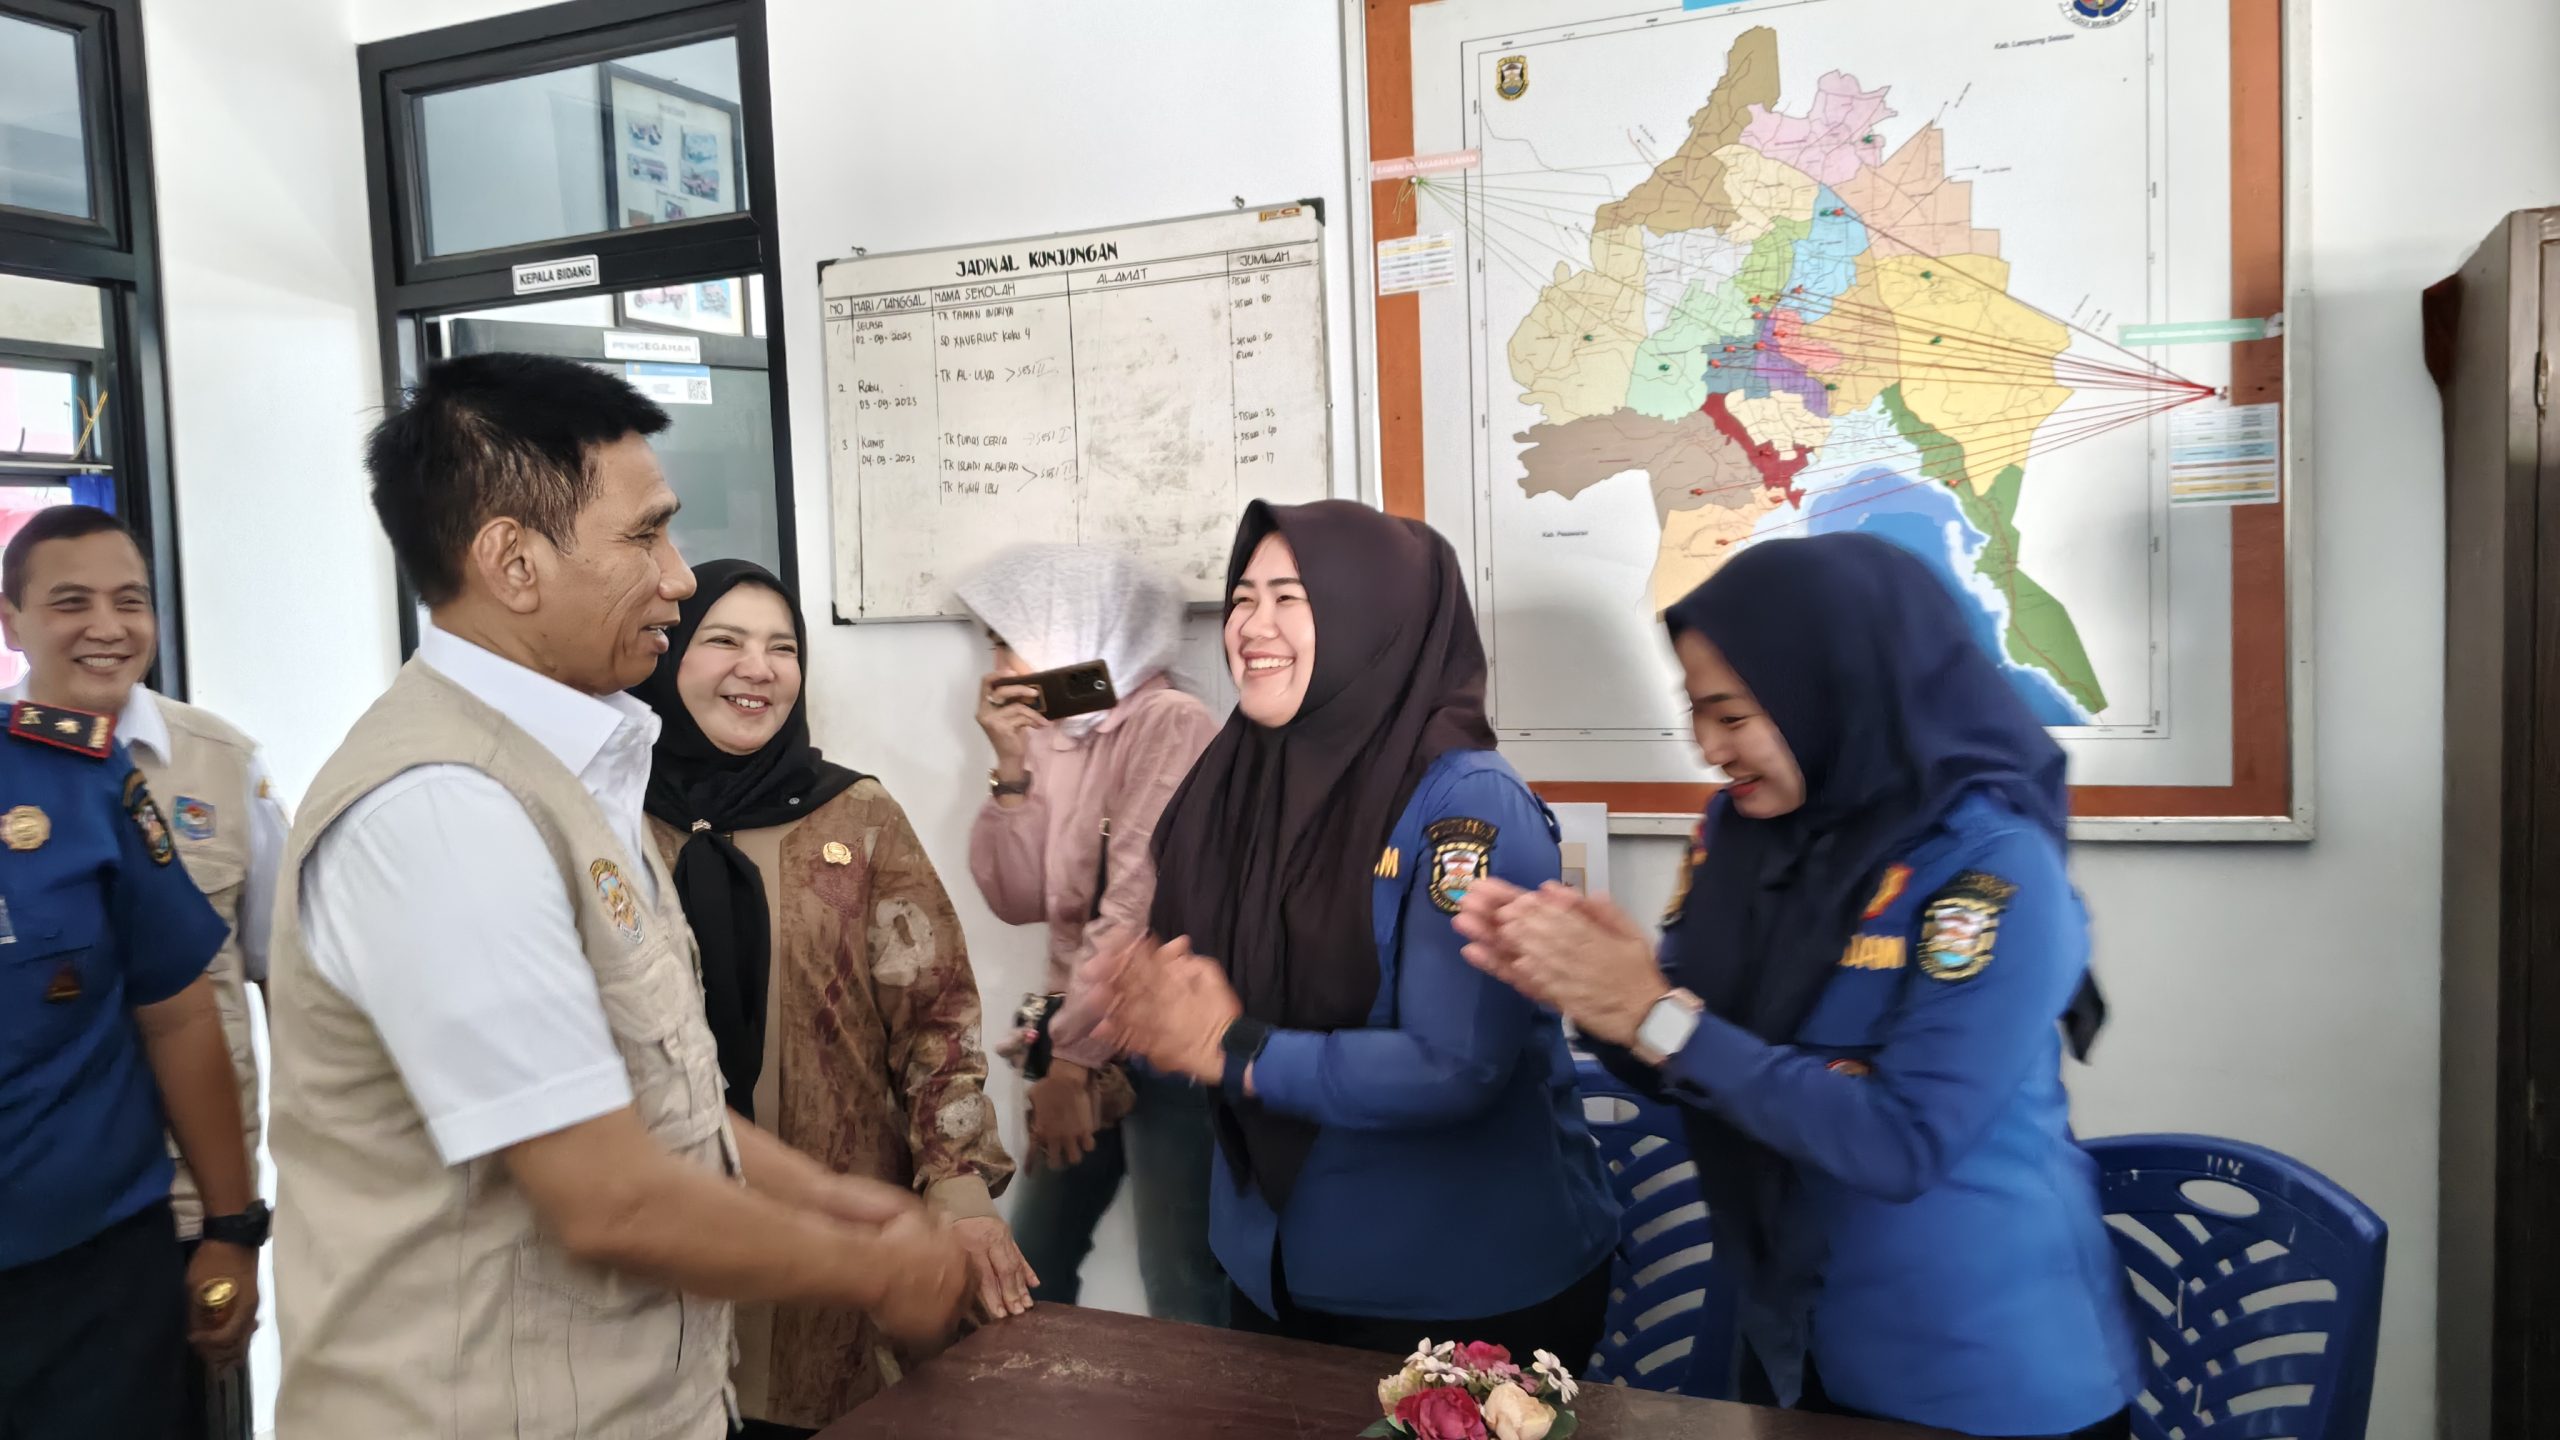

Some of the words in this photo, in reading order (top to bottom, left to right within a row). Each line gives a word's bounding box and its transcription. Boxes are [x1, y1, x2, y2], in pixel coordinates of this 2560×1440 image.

[1029, 241, 1118, 268] KUNJUNGAN
[1240, 250, 1290, 266] JUMLAH
[520, 270, 555, 285] KEPALA
[556, 265, 591, 280] BIDANG
[1096, 268, 1148, 284] ALAMAT
[935, 290, 960, 303] NAMA
[965, 282, 1016, 300] SEKOLAH
[830, 303, 843, 315] NO
[952, 309, 980, 320] TAMAN
[953, 331, 998, 348] XAVERIUS
[940, 369, 951, 382] TK
[944, 433, 954, 445] TK
[944, 459, 954, 471] TK
[942, 481, 953, 493] TK
